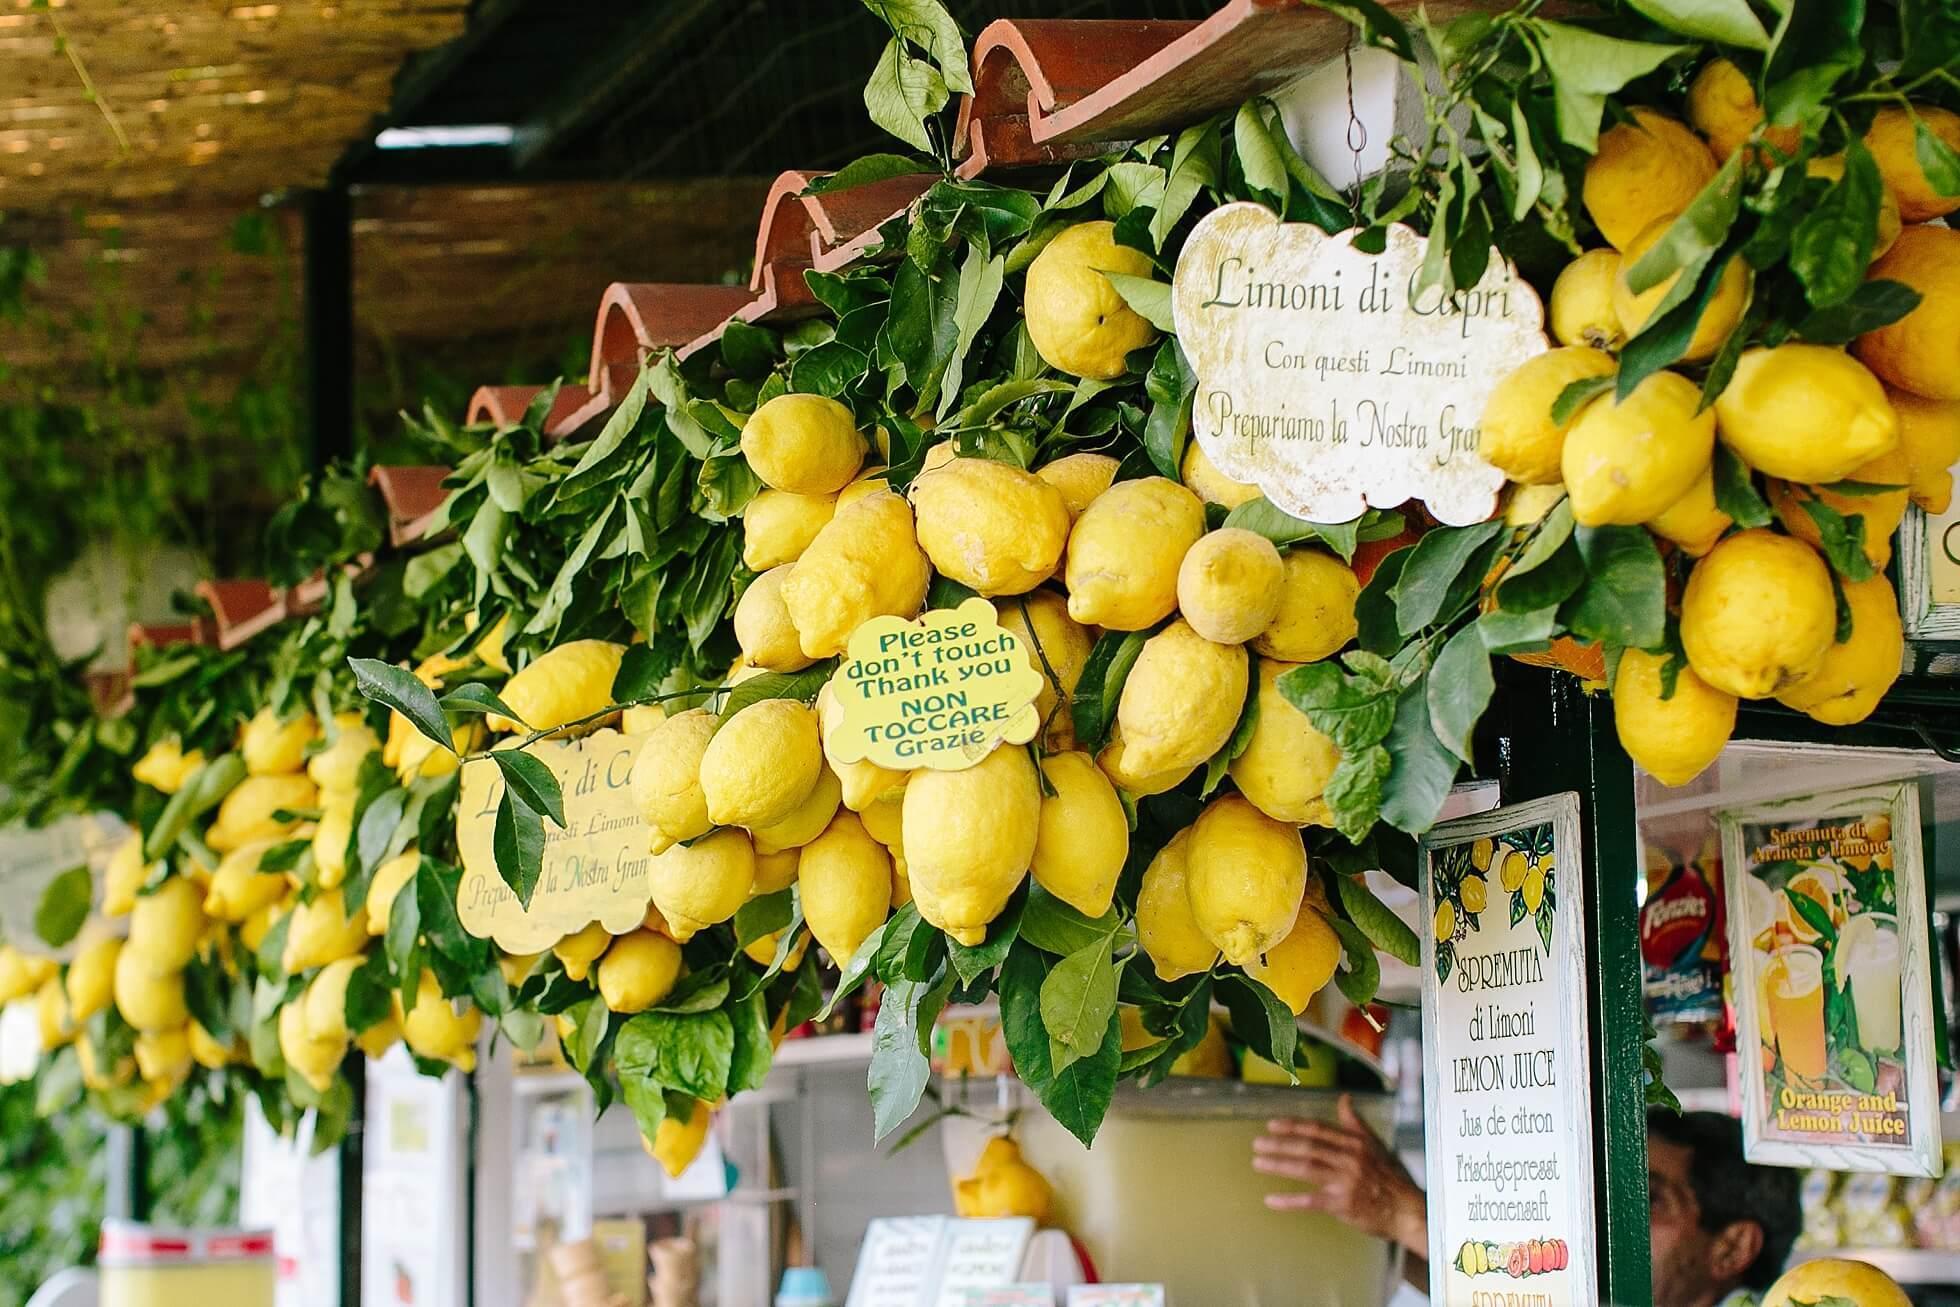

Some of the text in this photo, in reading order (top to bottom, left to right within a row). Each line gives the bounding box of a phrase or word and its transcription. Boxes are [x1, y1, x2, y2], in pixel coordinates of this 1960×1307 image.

[1201, 257, 1344, 312] Limoni
[1358, 262, 1393, 314] di
[1264, 340, 1468, 381] Con questi Limoni
[1208, 391, 1324, 456] Prepariamo
[1332, 398, 1348, 444] la
[1356, 400, 1428, 449] Nostra
[847, 634, 1015, 679] don't touch
[880, 623, 977, 653] Please
[856, 658, 1011, 699] Thank you
[864, 702, 1010, 743] TOCCARE
[901, 691, 968, 718] NON
[895, 729, 986, 757] Grazie
[575, 758, 598, 796] di
[1770, 822, 1868, 846] Spremuta di
[1752, 845, 1812, 864] Arancia
[1816, 845, 1827, 858] e
[546, 862, 558, 894] la
[564, 855, 609, 892] Nostra
[1458, 946, 1544, 992] SPREMUTA
[1469, 1001, 1535, 1041] di Limoni
[1453, 1049, 1556, 1092] LEMON JUICE
[1781, 1087, 1897, 1113] Orange and
[1459, 1105, 1554, 1137] Jus de citron
[1777, 1109, 1905, 1136] Lemon Juice
[1456, 1151, 1560, 1192] Frischgepresst
[1468, 1190, 1551, 1222] zitronensaft
